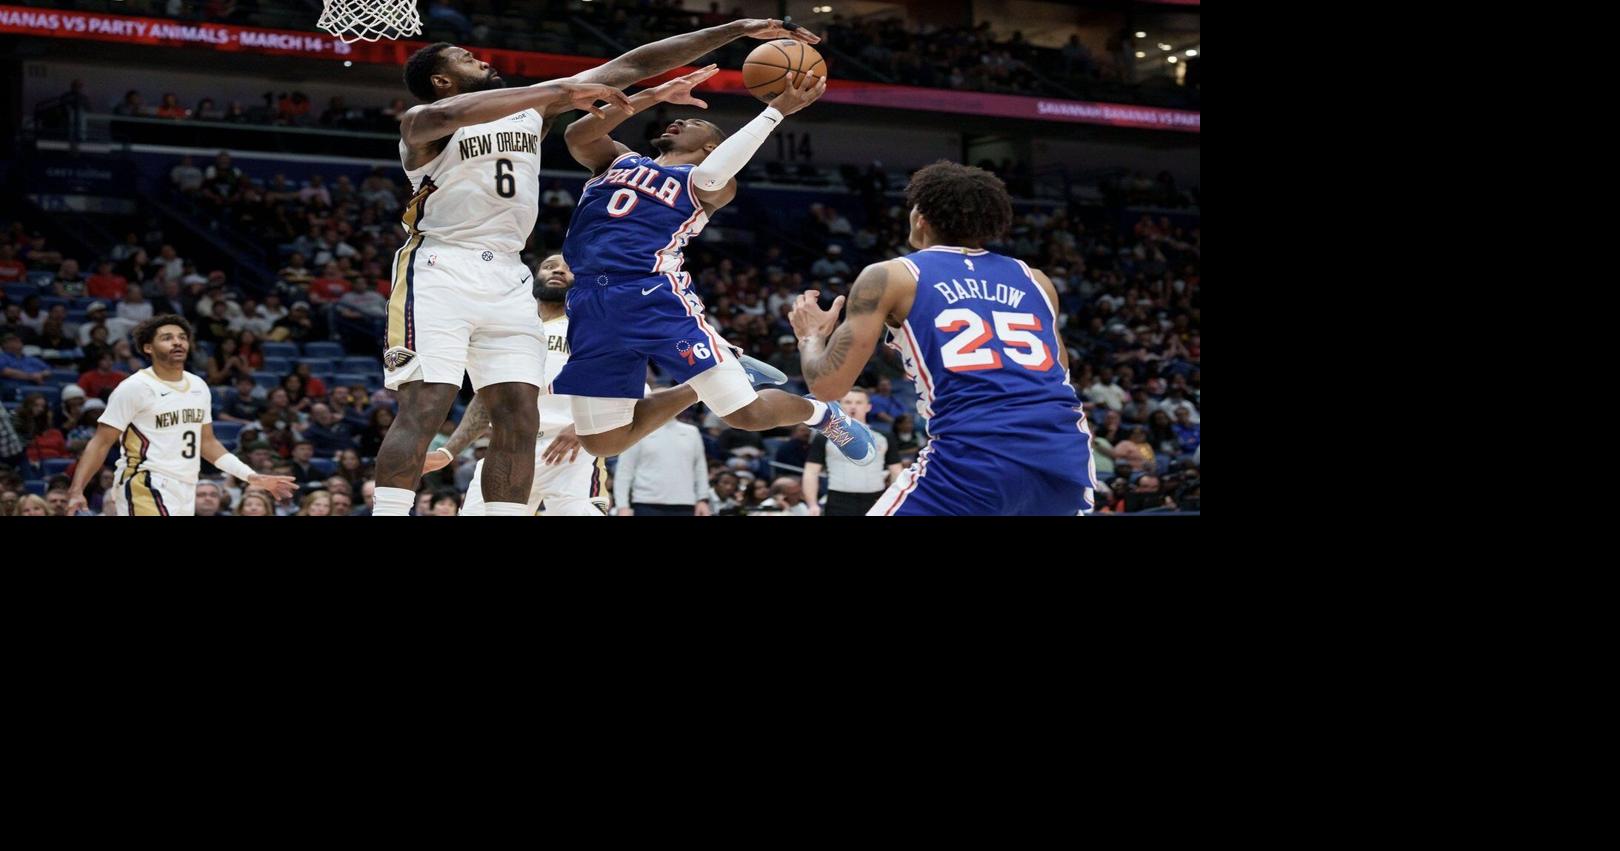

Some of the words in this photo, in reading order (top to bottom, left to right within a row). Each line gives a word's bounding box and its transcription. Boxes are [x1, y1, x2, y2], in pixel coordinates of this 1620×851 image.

[62, 15, 87, 32] VS
[88, 18, 147, 37] PARTY
[149, 23, 229, 45] ANIMALS
[239, 31, 302, 50] MARCH
[304, 37, 323, 52] 14
[333, 40, 351, 54] 15
[1037, 101, 1101, 118] SAVANNAH
[1103, 107, 1157, 124] BANANAS
[1158, 112, 1172, 124] VS
[458, 133, 492, 161] NEW
[496, 131, 538, 156] ORLEANS
[775, 132, 813, 161] 114
[494, 158, 516, 199] 6
[604, 164, 683, 208] PHILA
[606, 187, 640, 218] 0
[933, 277, 1026, 309] BARLOW
[676, 339, 711, 367] 76
[934, 308, 1055, 373] 25
[155, 410, 180, 430] NEW
[181, 430, 196, 460] 3
